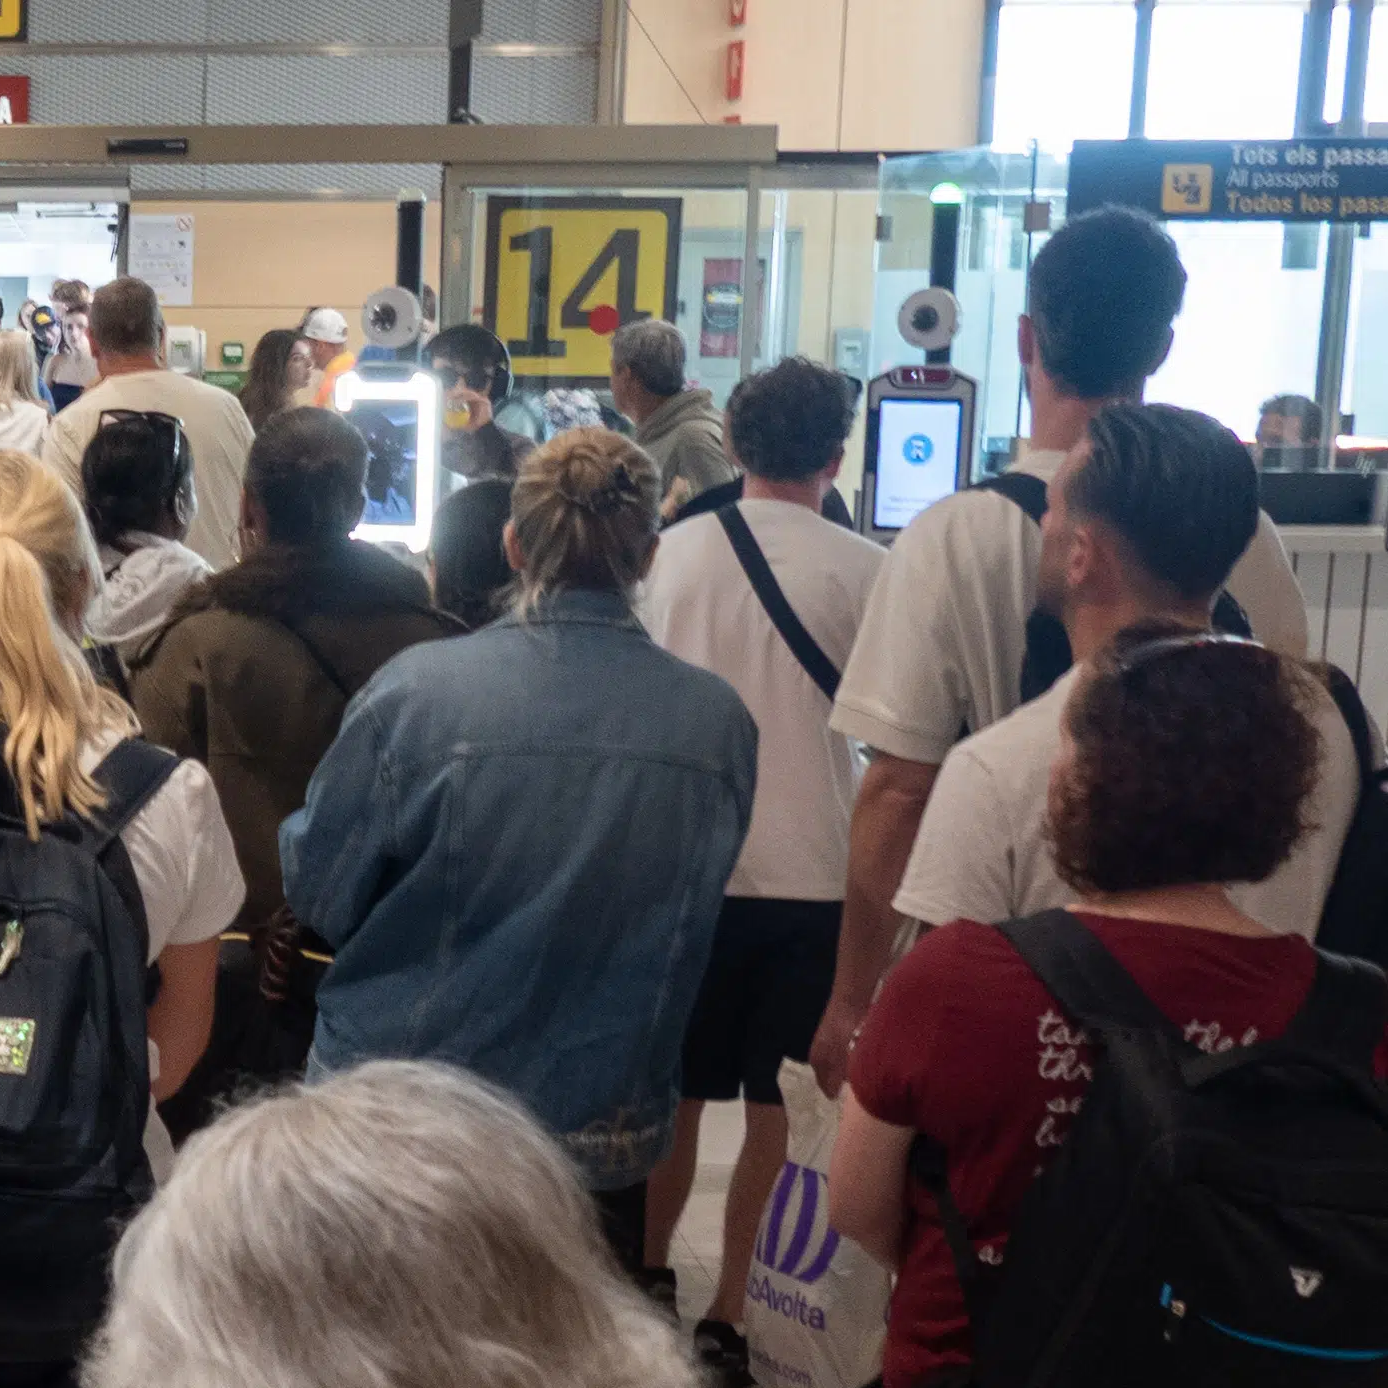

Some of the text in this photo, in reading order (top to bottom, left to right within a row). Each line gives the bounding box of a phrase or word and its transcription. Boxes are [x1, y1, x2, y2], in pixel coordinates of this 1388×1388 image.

[1232, 144, 1278, 166] Tots
[1284, 144, 1318, 166] els
[1226, 169, 1339, 190] All passports
[1227, 191, 1294, 213] Todos
[1300, 192, 1332, 213] los
[508, 226, 653, 358] 14
